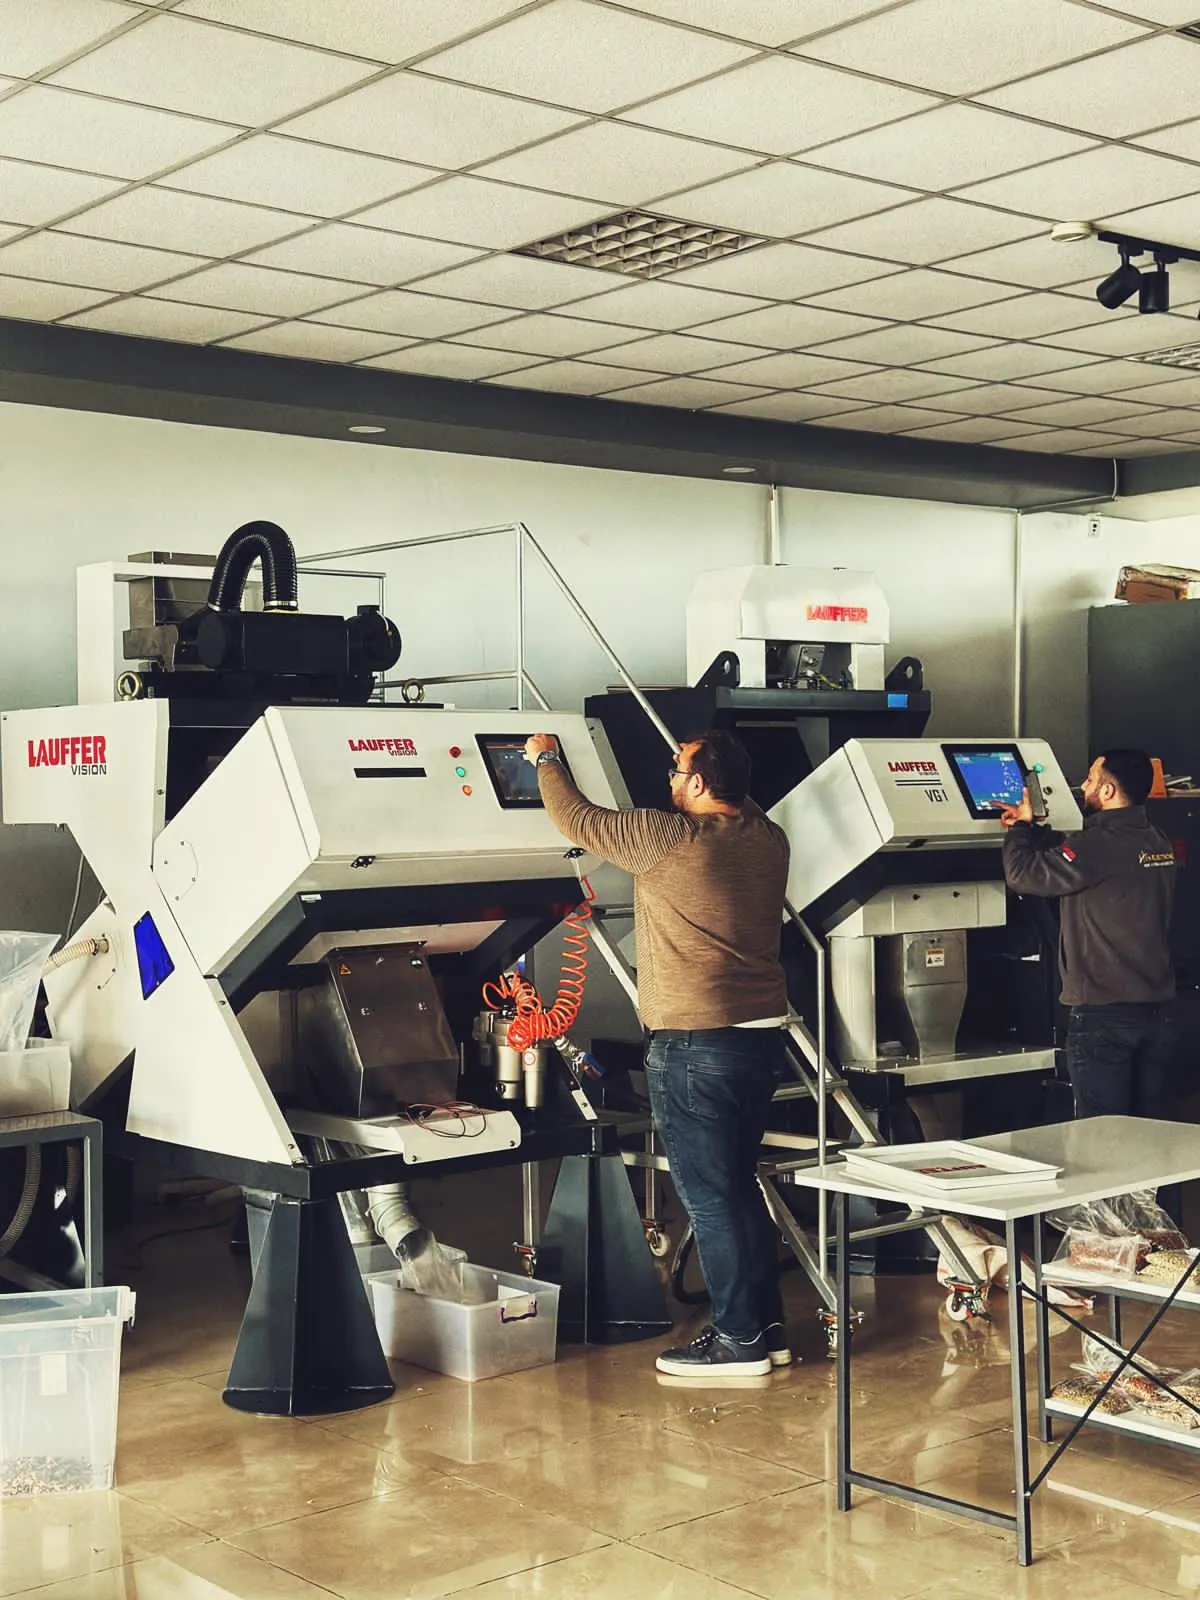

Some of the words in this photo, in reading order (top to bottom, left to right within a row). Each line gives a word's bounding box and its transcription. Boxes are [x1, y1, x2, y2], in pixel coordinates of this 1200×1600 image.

[348, 738, 416, 751] LAUFFER
[28, 735, 106, 768] LAUFFER
[388, 749, 418, 757] VISION
[70, 764, 107, 776] VISION
[887, 761, 938, 772] LAUFFER
